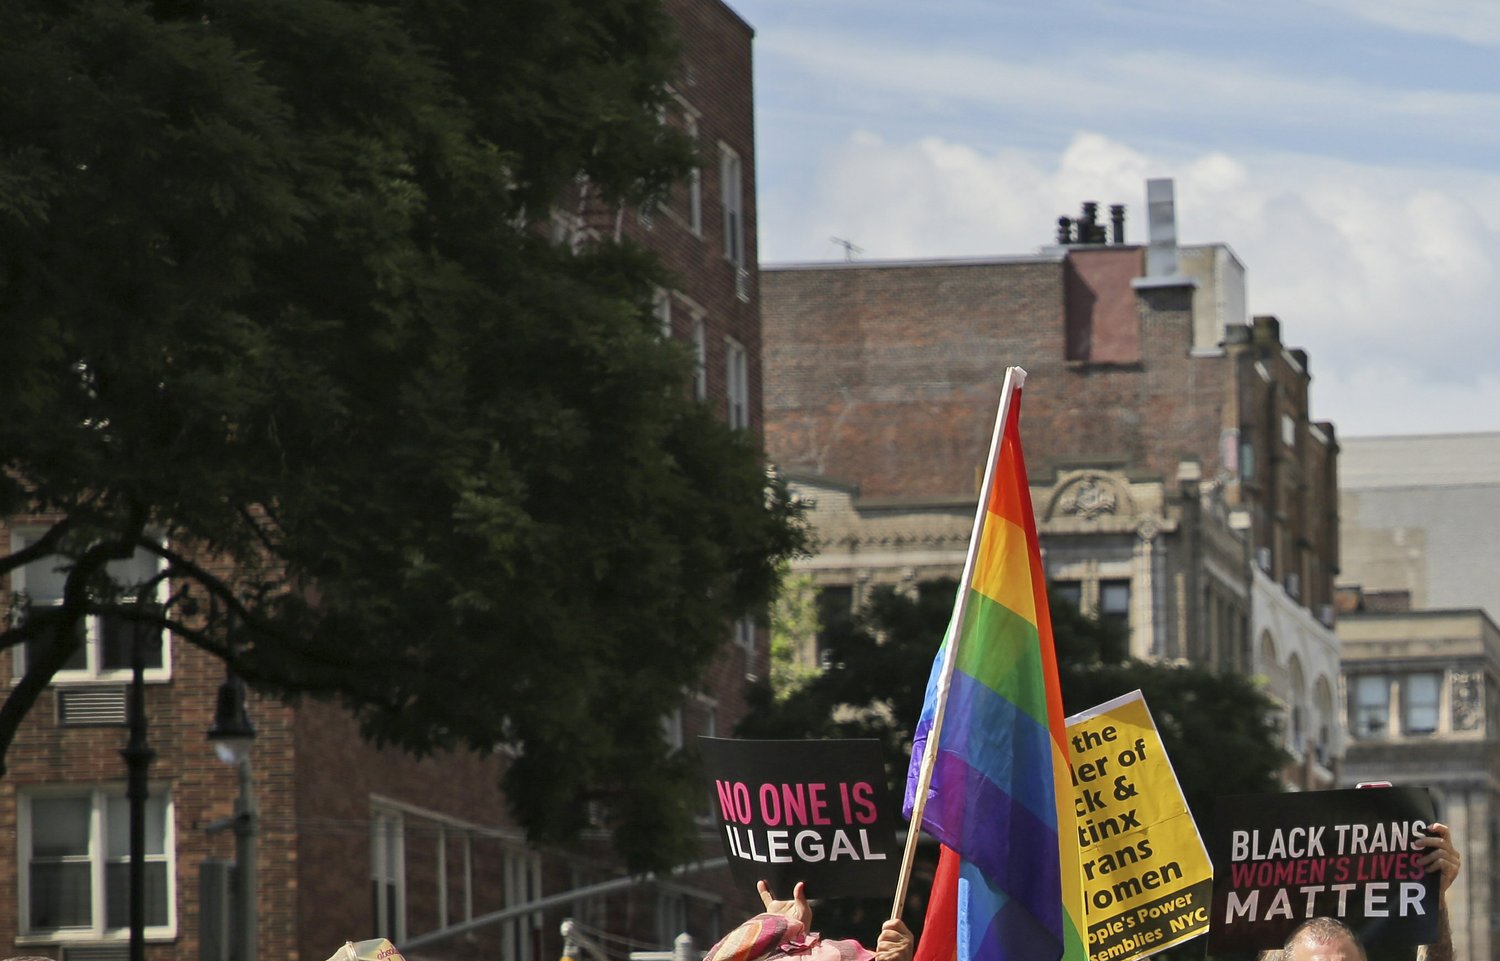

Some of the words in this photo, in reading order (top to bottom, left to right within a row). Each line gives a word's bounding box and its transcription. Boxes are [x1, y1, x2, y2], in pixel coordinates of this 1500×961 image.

[1071, 725, 1118, 754] the
[1117, 738, 1147, 768] of
[716, 779, 752, 825] NO
[759, 783, 831, 826] ONE
[839, 781, 878, 825] IS
[1075, 789, 1107, 817] ck
[1113, 775, 1139, 801] &
[725, 825, 887, 863] ILLEGAL
[1078, 808, 1142, 848] tinx
[1231, 826, 1326, 862] BLACK
[1332, 820, 1427, 856] TRANS
[1082, 838, 1153, 881] rans
[1231, 856, 1351, 889] WOMEN'S
[1357, 853, 1426, 881] LIVES
[1085, 860, 1183, 914] omen
[1225, 882, 1427, 925] MATTER
[1088, 911, 1135, 946] ople's
[1139, 891, 1194, 924] Power
[1170, 907, 1208, 934] NYC
